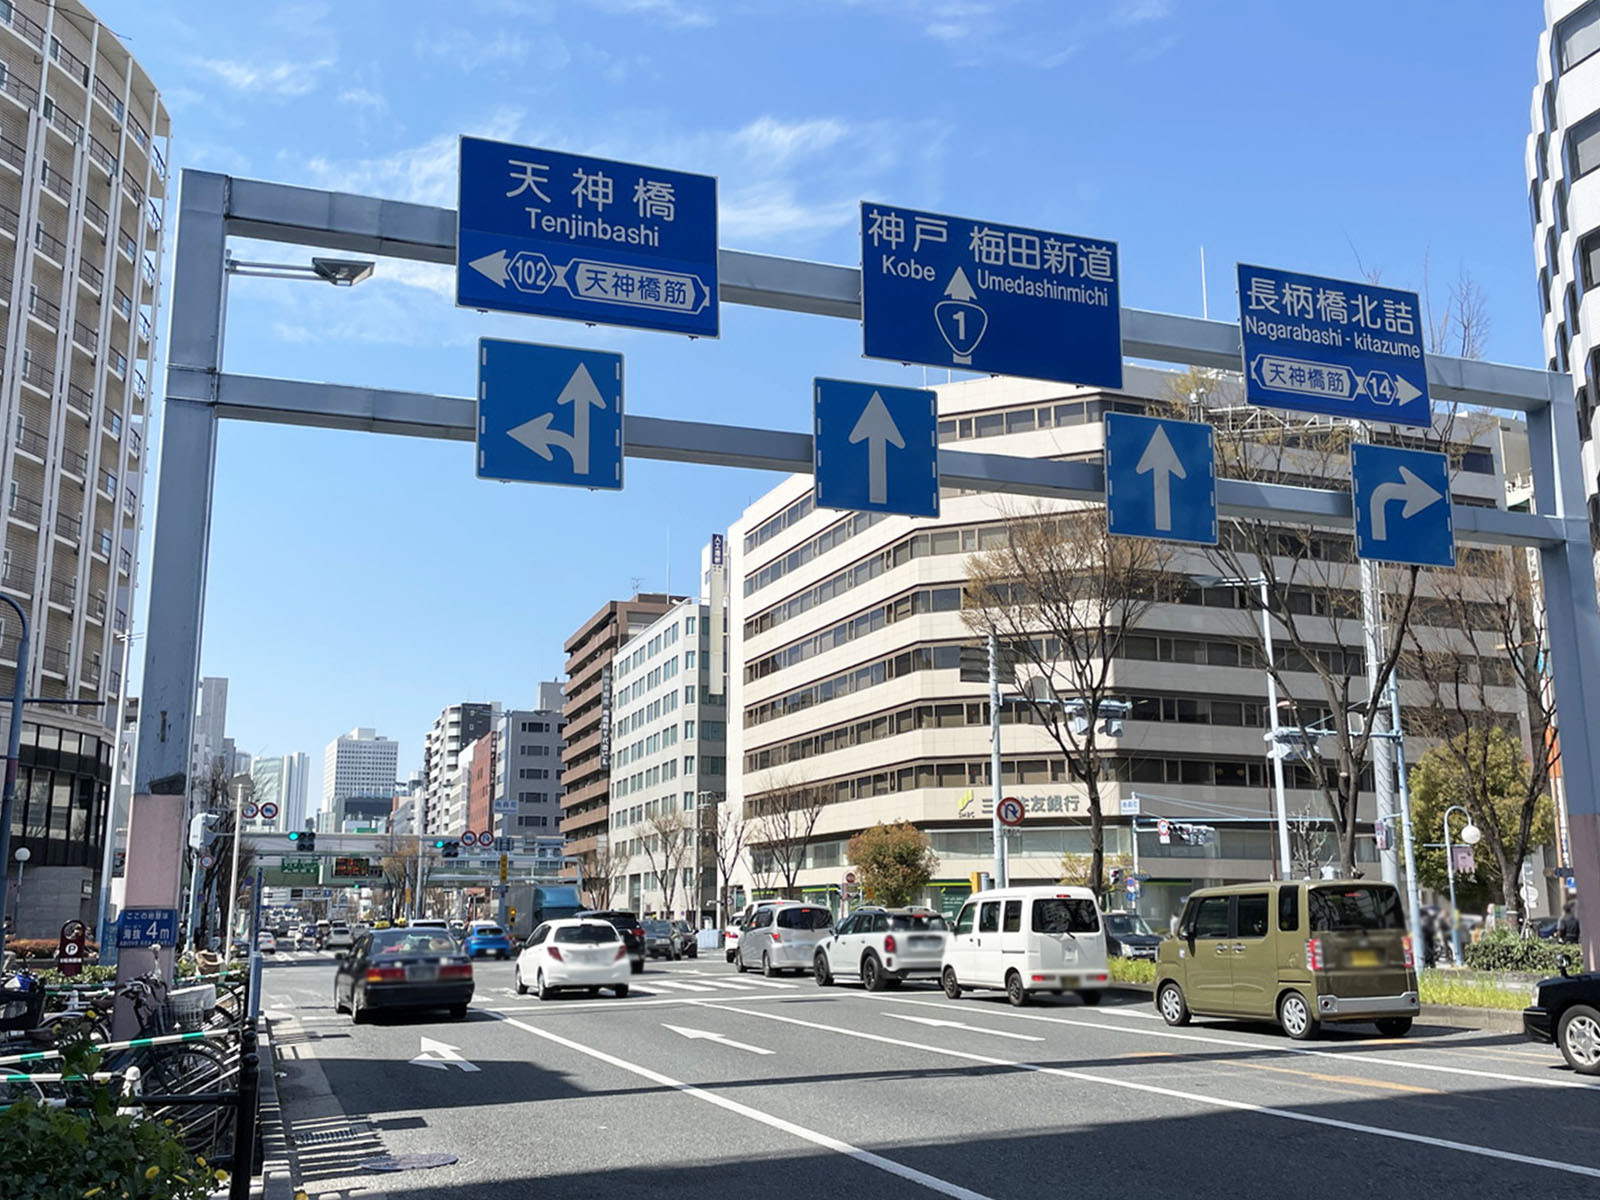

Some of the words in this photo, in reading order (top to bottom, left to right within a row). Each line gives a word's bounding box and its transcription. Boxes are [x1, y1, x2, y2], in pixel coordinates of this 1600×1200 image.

[505, 159, 677, 222] 天神橋
[525, 206, 660, 248] Tenjinbashi
[867, 208, 948, 253] 神戸
[515, 259, 547, 287] 102
[882, 254, 936, 281] Kobe
[968, 225, 1115, 284] 梅田新道
[584, 268, 687, 306] 天神橋筋
[977, 268, 1109, 307] Umedashinmichi
[952, 310, 966, 341] 1
[1247, 277, 1415, 336] 長柄橋北詰
[1269, 362, 1345, 394] 天神橋筋
[1369, 377, 1393, 399] 14
[981, 795, 1081, 813] 三友銀行
